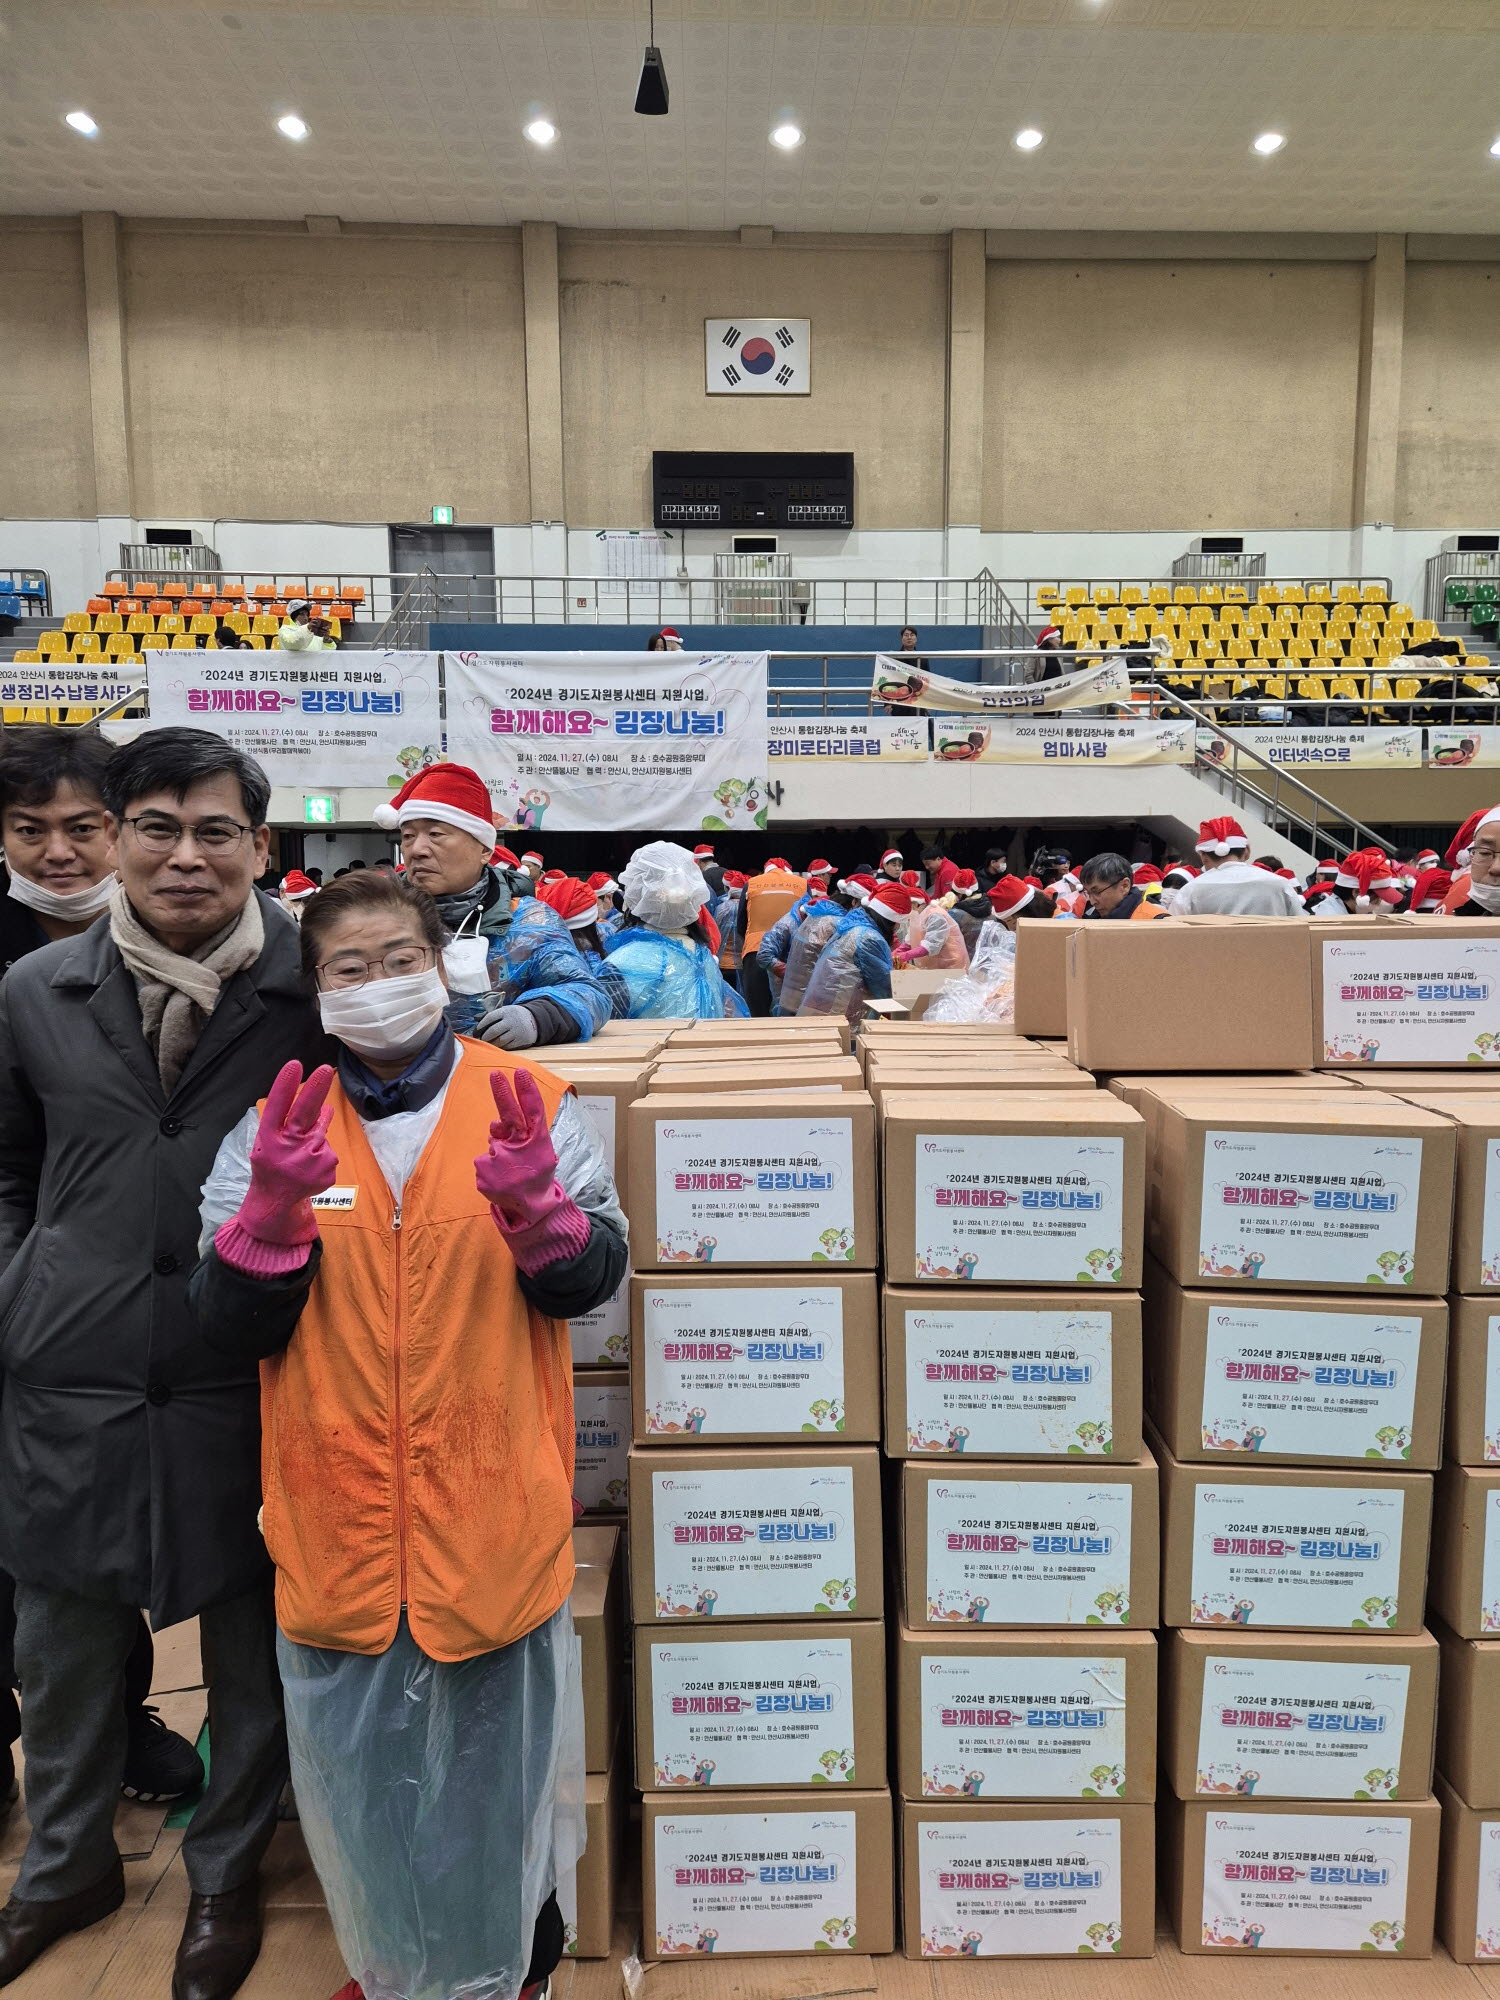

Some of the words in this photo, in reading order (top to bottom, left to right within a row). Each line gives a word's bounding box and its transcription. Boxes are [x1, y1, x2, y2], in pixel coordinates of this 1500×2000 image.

[48, 672, 98, 680] 통합김장나눔
[101, 672, 118, 680] 축제
[249, 670, 338, 683] 경기도자원봉사센터
[559, 688, 655, 701] 경기도자원봉사센터
[188, 690, 295, 711] 함께해요~
[302, 690, 402, 713] 김장나눔!
[490, 710, 608, 734] 함께해요~
[615, 711, 724, 734] 김장나눔!
[770, 726, 795, 735] 안산시
[798, 725, 847, 735] 통합김장나눔
[850, 725, 867, 734] 축제
[1016, 728, 1035, 736] 2024
[1039, 728, 1063, 737] 안산시
[1066, 728, 1115, 737] 통합김장나눔
[1118, 728, 1134, 737] 축제
[1276, 736, 1298, 744] 안산시
[1301, 735, 1346, 744] 통합김장나눔
[1349, 735, 1364, 743] 축제
[1043, 741, 1107, 758] 엄마사랑
[1269, 748, 1350, 762] 인터넷속으로
[539, 767, 579, 775] 안산뜰봉사단
[632, 767, 692, 775] 안산시자원봉사센터
[1418, 985, 1487, 999] 김장나눔!
[720, 1159, 785, 1167] 경기도자원봉사센터
[758, 1173, 832, 1189] 김장나눔!
[983, 1175, 1052, 1185] 경기도자원봉사센터
[1274, 1173, 1346, 1185] 경기도자원봉사센터
[1022, 1190, 1101, 1209] 김장나눔!
[1314, 1190, 1396, 1211] 김장나눔!
[710, 1329, 775, 1337] 경기도자원봉사센터
[748, 1343, 822, 1360] 김장나눔!
[973, 1350, 1041, 1359] 경기도자원봉사센터
[1276, 1350, 1347, 1362] 경기도자원봉사센터
[1012, 1365, 1090, 1383] 김장나눔!
[1314, 1366, 1395, 1388] 김장나눔!
[720, 1509, 787, 1519] 경기도자원봉사센터
[994, 1520, 1062, 1530] 경기도자원봉사센터
[1262, 1525, 1331, 1535] 경기도자원봉사센터
[759, 1523, 834, 1541] 김장나눔!
[1033, 1536, 1110, 1554] 김장나눔!
[1300, 1540, 1379, 1559] 김장나눔!
[718, 1681, 784, 1690] 경기도자원봉사센터
[756, 1694, 831, 1712] 김장나눔!
[988, 1695, 1056, 1704] 경기도자원봉사센터
[1270, 1697, 1338, 1709] 경기도자원봉사센터
[1027, 1710, 1104, 1727] 김장나눔!
[1307, 1713, 1385, 1732] 김장나눔!
[721, 1852, 788, 1861] 경기도자원봉사센터
[985, 1858, 1052, 1867] 경기도자원봉사센터
[1272, 1851, 1340, 1862] 경기도자원봉사센터
[760, 1865, 835, 1882] 김장나눔!
[1024, 1872, 1100, 1888] 김장나눔!
[1310, 1866, 1387, 1885] 김장나눔!
